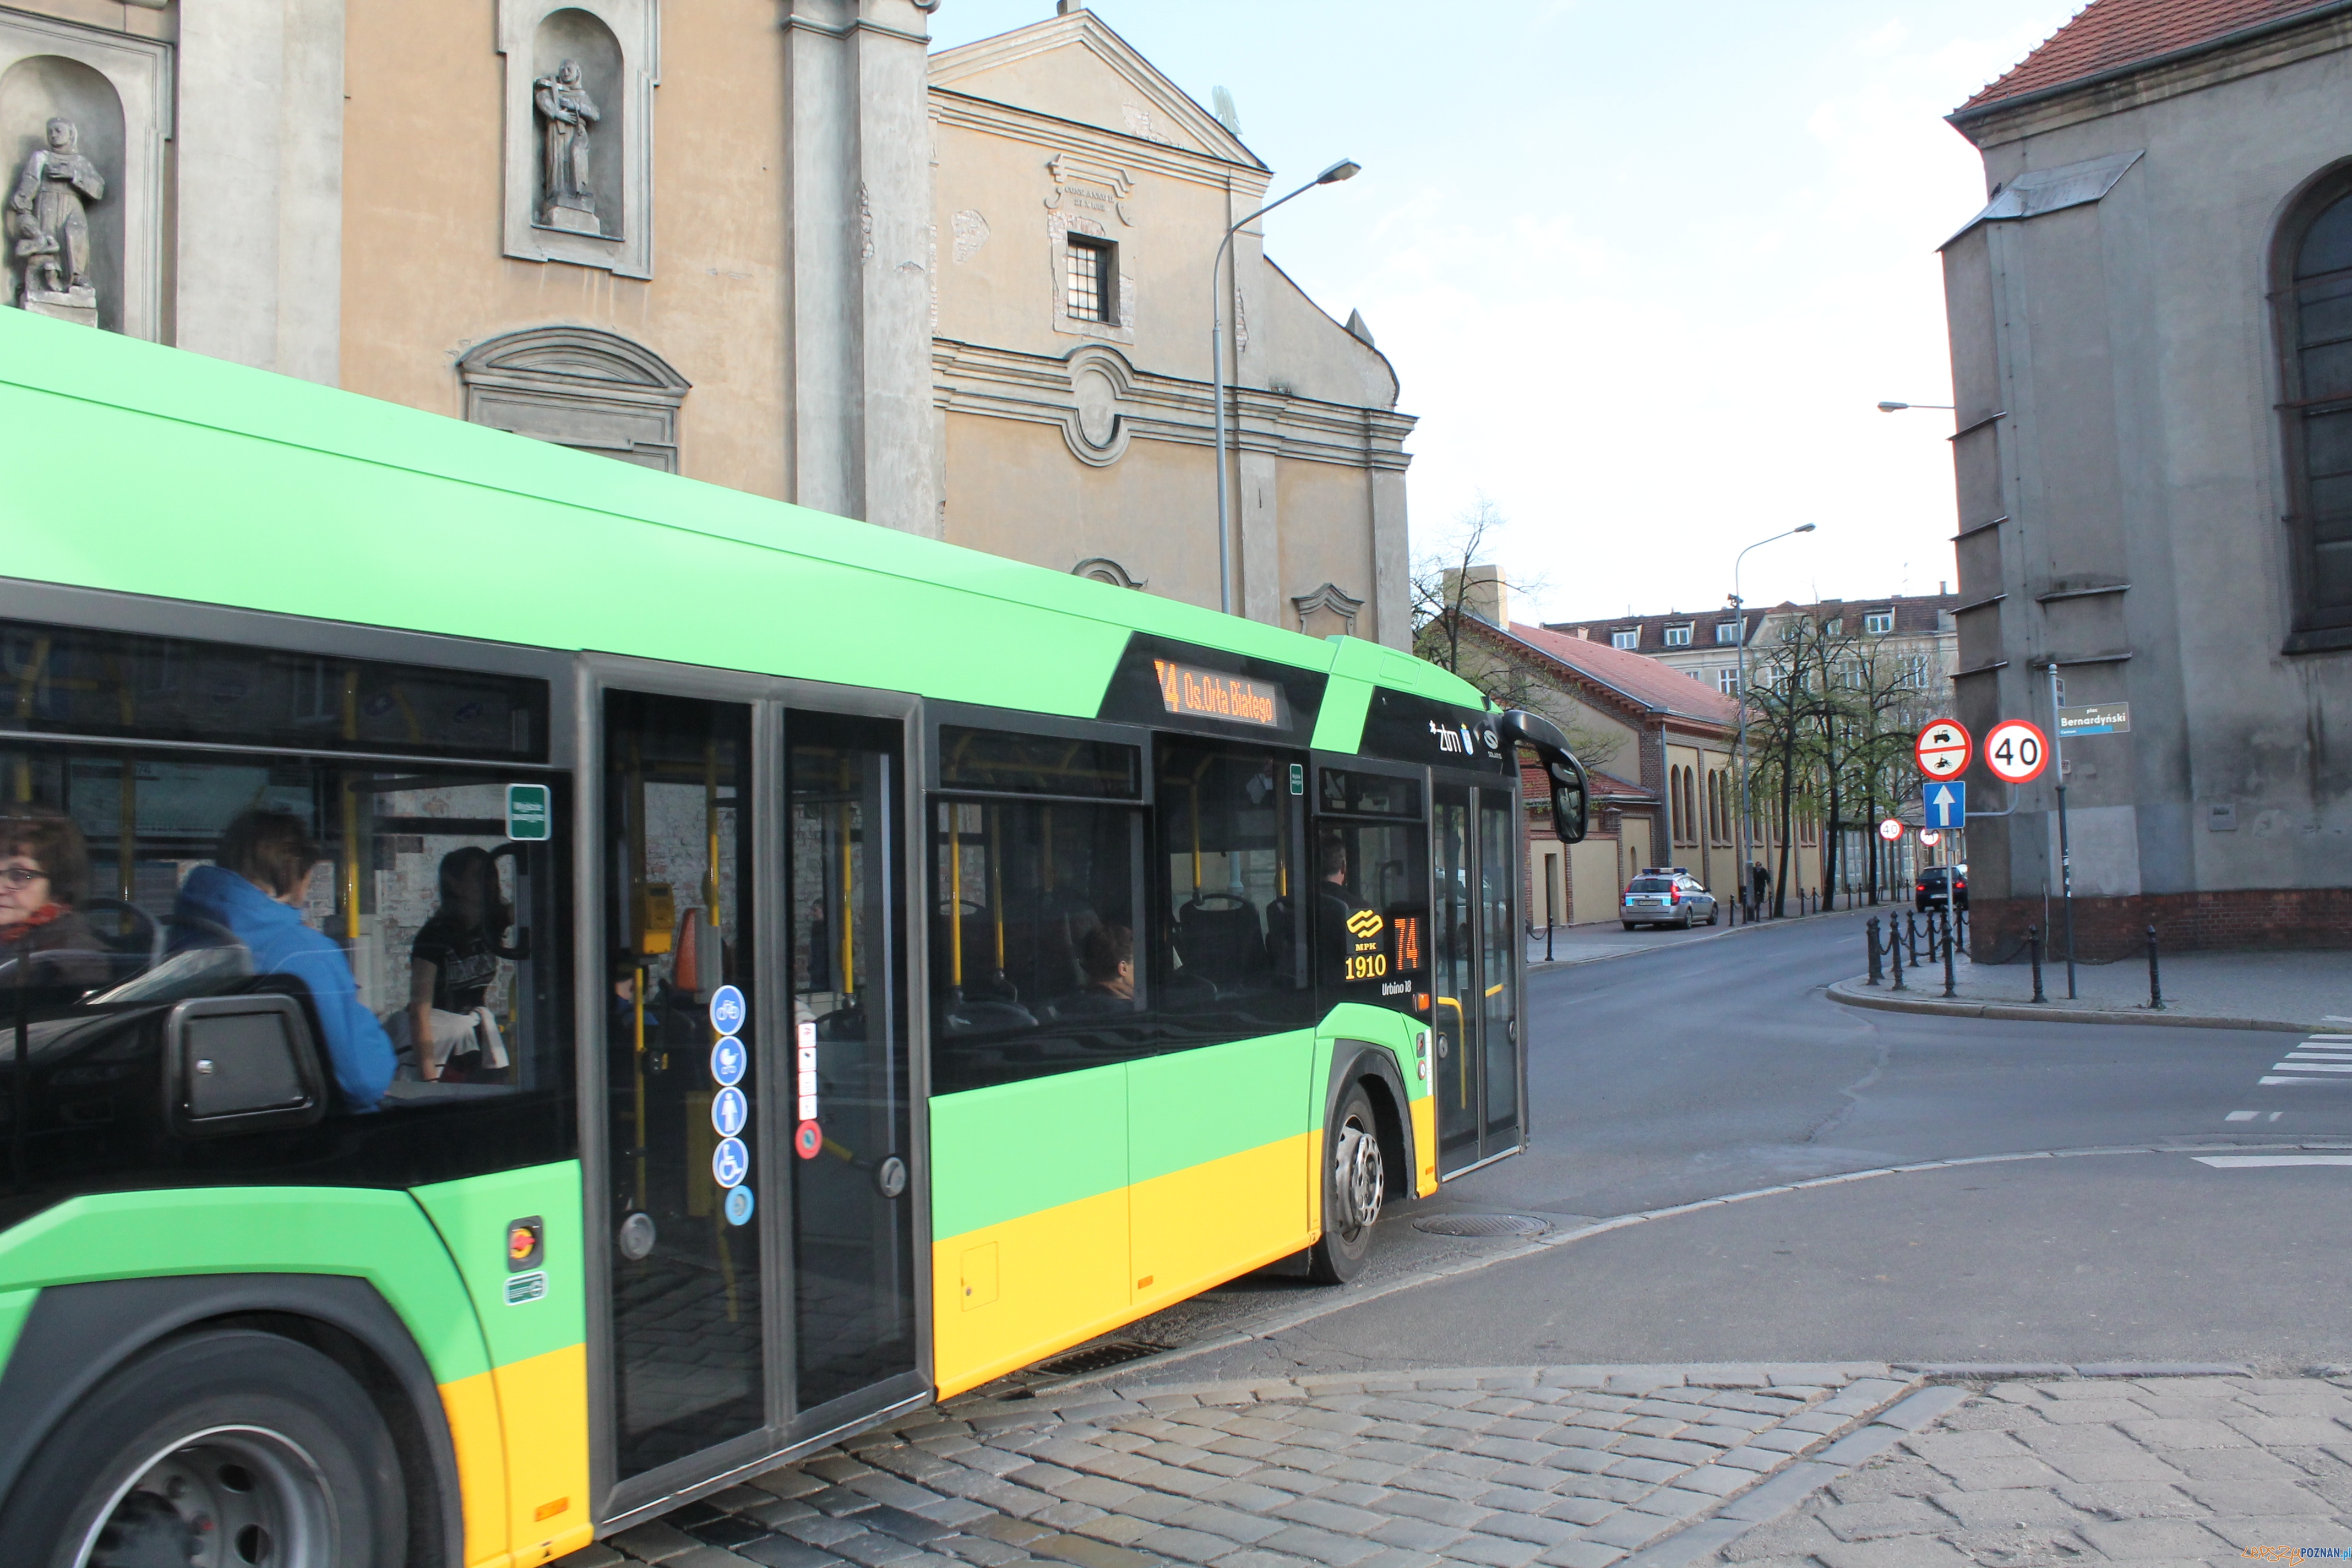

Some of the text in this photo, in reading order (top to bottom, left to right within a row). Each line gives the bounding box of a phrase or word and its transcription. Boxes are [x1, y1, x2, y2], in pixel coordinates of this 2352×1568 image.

[1229, 680, 1272, 723] Białego
[2061, 712, 2126, 727] Bernardyński
[1995, 738, 2038, 766] 40
[1882, 824, 1898, 835] 40
[1355, 942, 1377, 951] MPK
[1395, 918, 1418, 970] 74
[1345, 954, 1387, 980] 1910
[1382, 979, 1412, 996] Urbino 18
